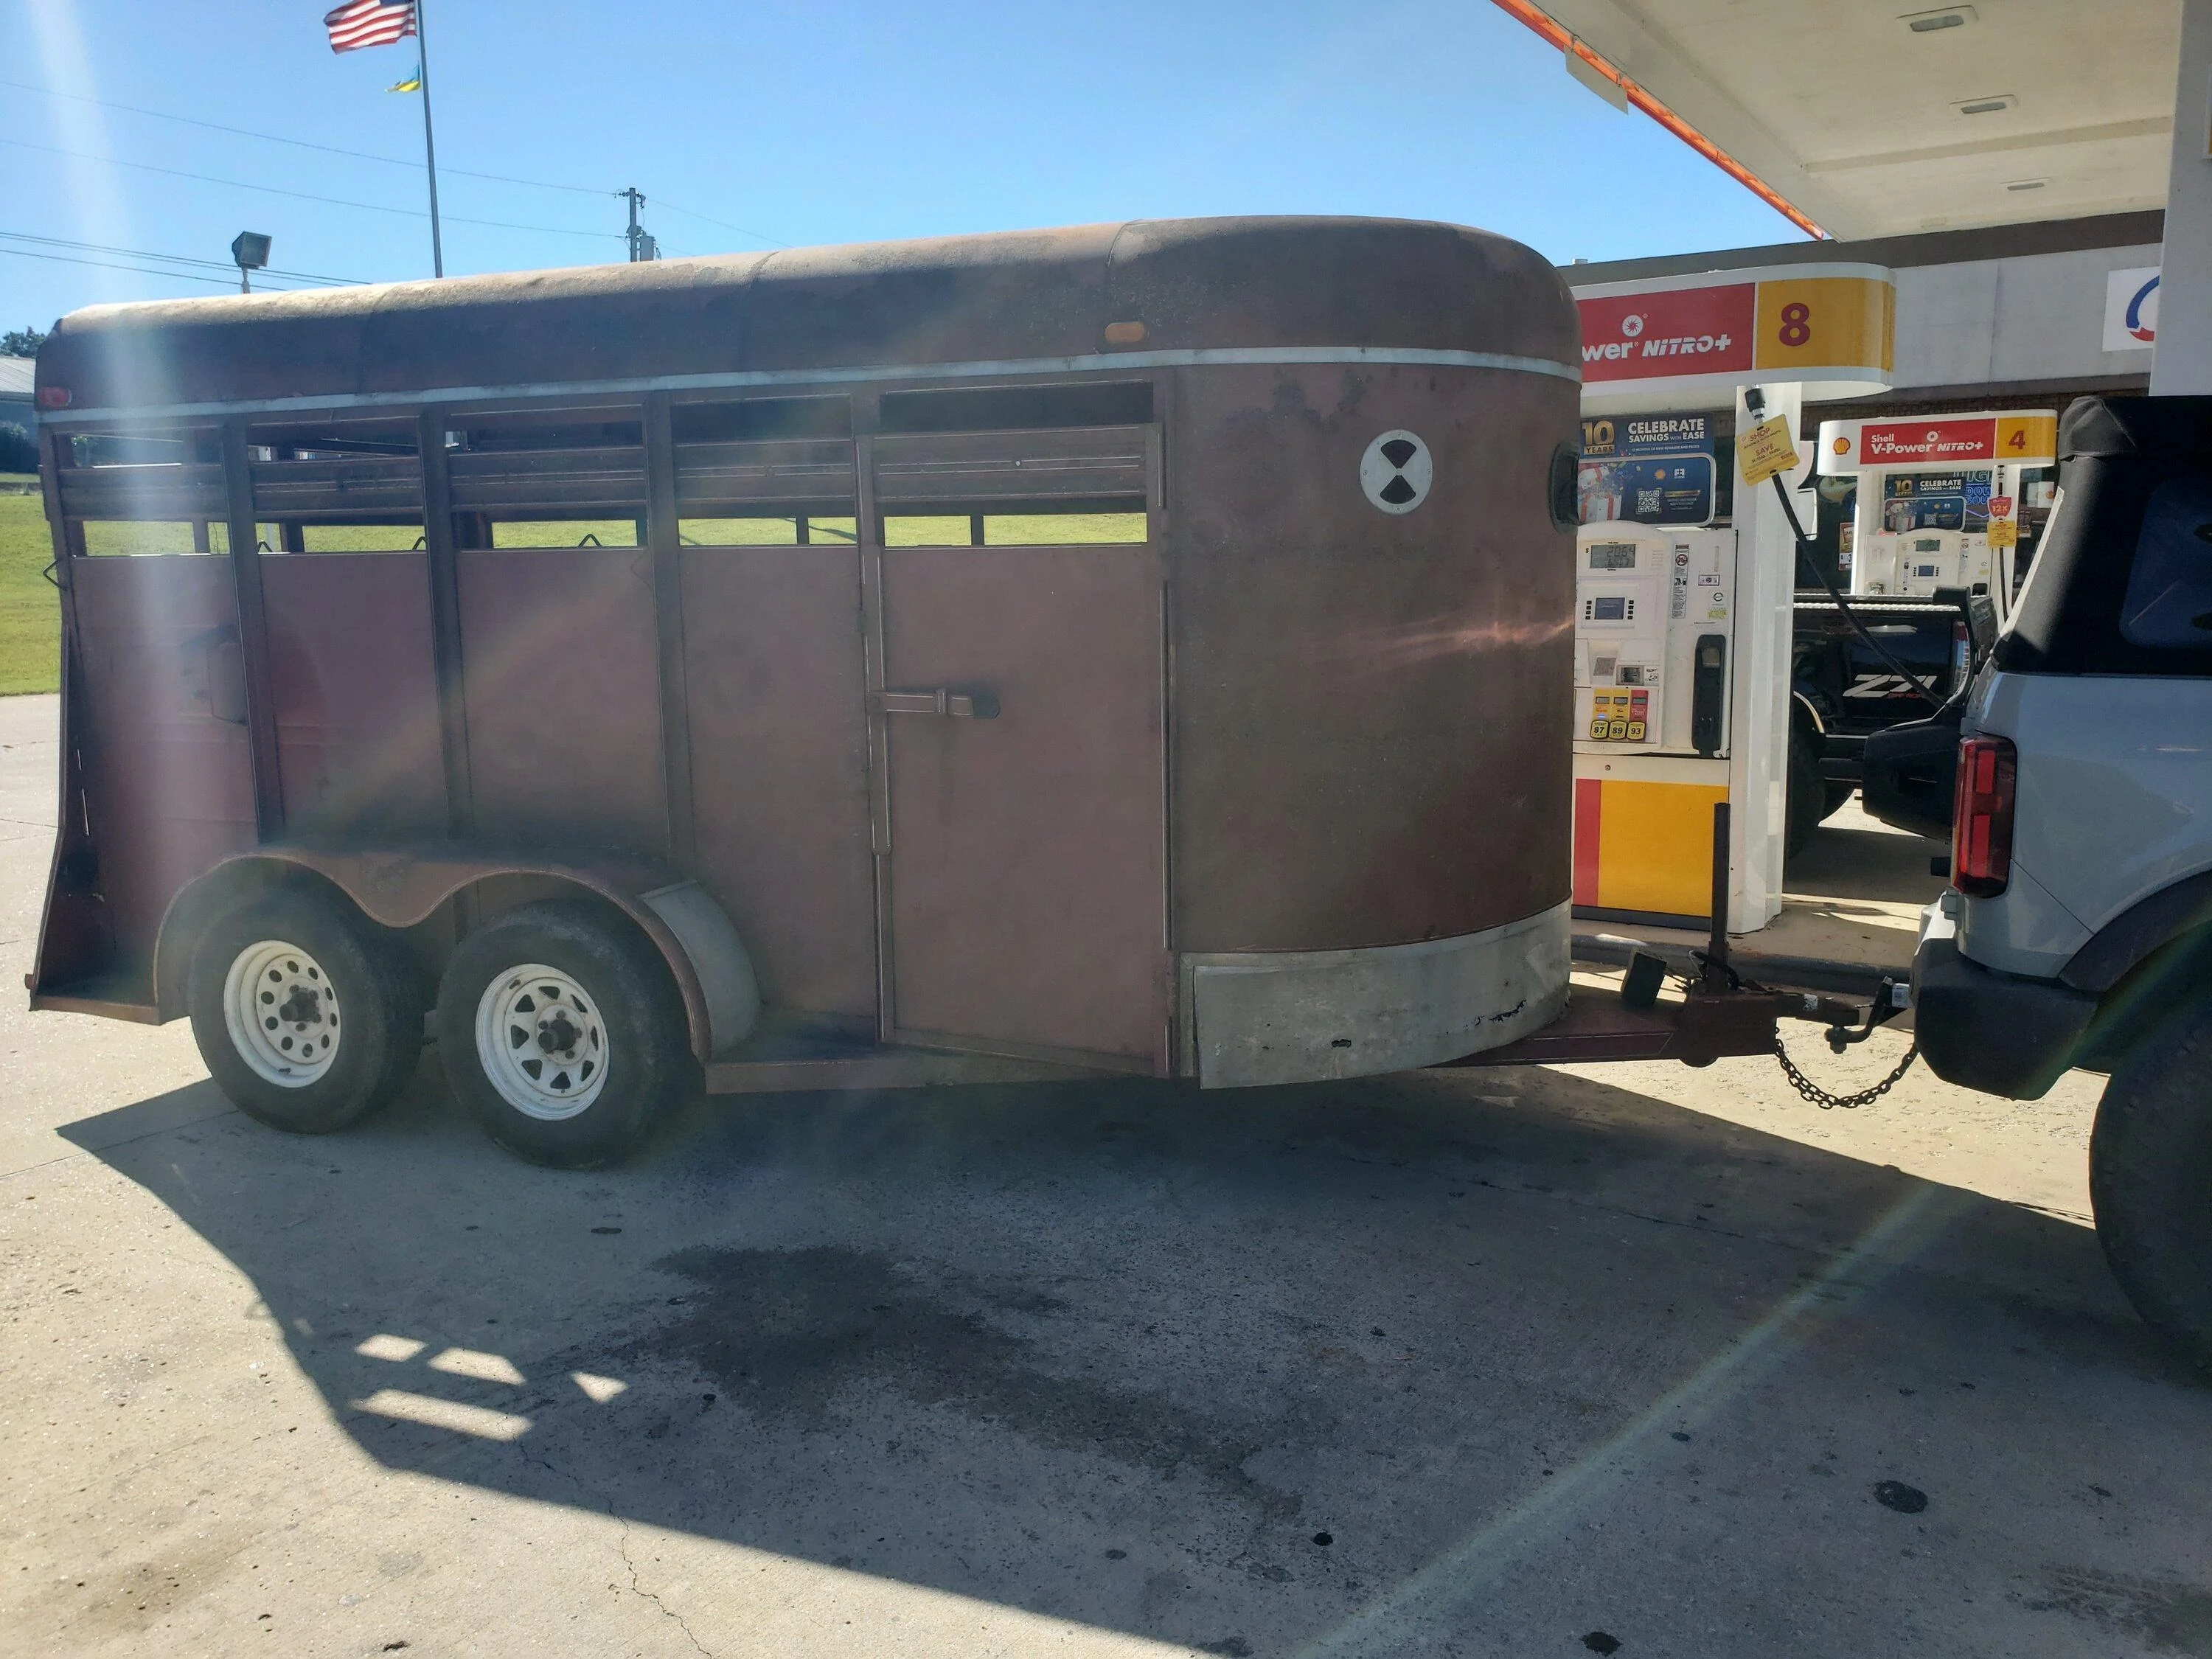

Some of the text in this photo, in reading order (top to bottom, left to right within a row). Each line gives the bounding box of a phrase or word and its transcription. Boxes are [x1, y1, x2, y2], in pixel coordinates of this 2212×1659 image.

[1778, 302, 1810, 347] 8
[1582, 420, 1615, 445] 10
[1627, 418, 1705, 435] CELEBRATE
[1628, 434, 1669, 443] SAVINGS
[1683, 431, 1705, 440] EASE
[1750, 428, 1770, 442] SHOP
[1871, 434, 1894, 443] Shell
[2008, 430, 2026, 450] 4
[1586, 445, 1613, 454] YEARS
[1756, 443, 1775, 456] SAVE
[1871, 442, 1933, 454] V-Power
[1895, 479, 1913, 492] 10
[1843, 674, 1937, 698] Z71
